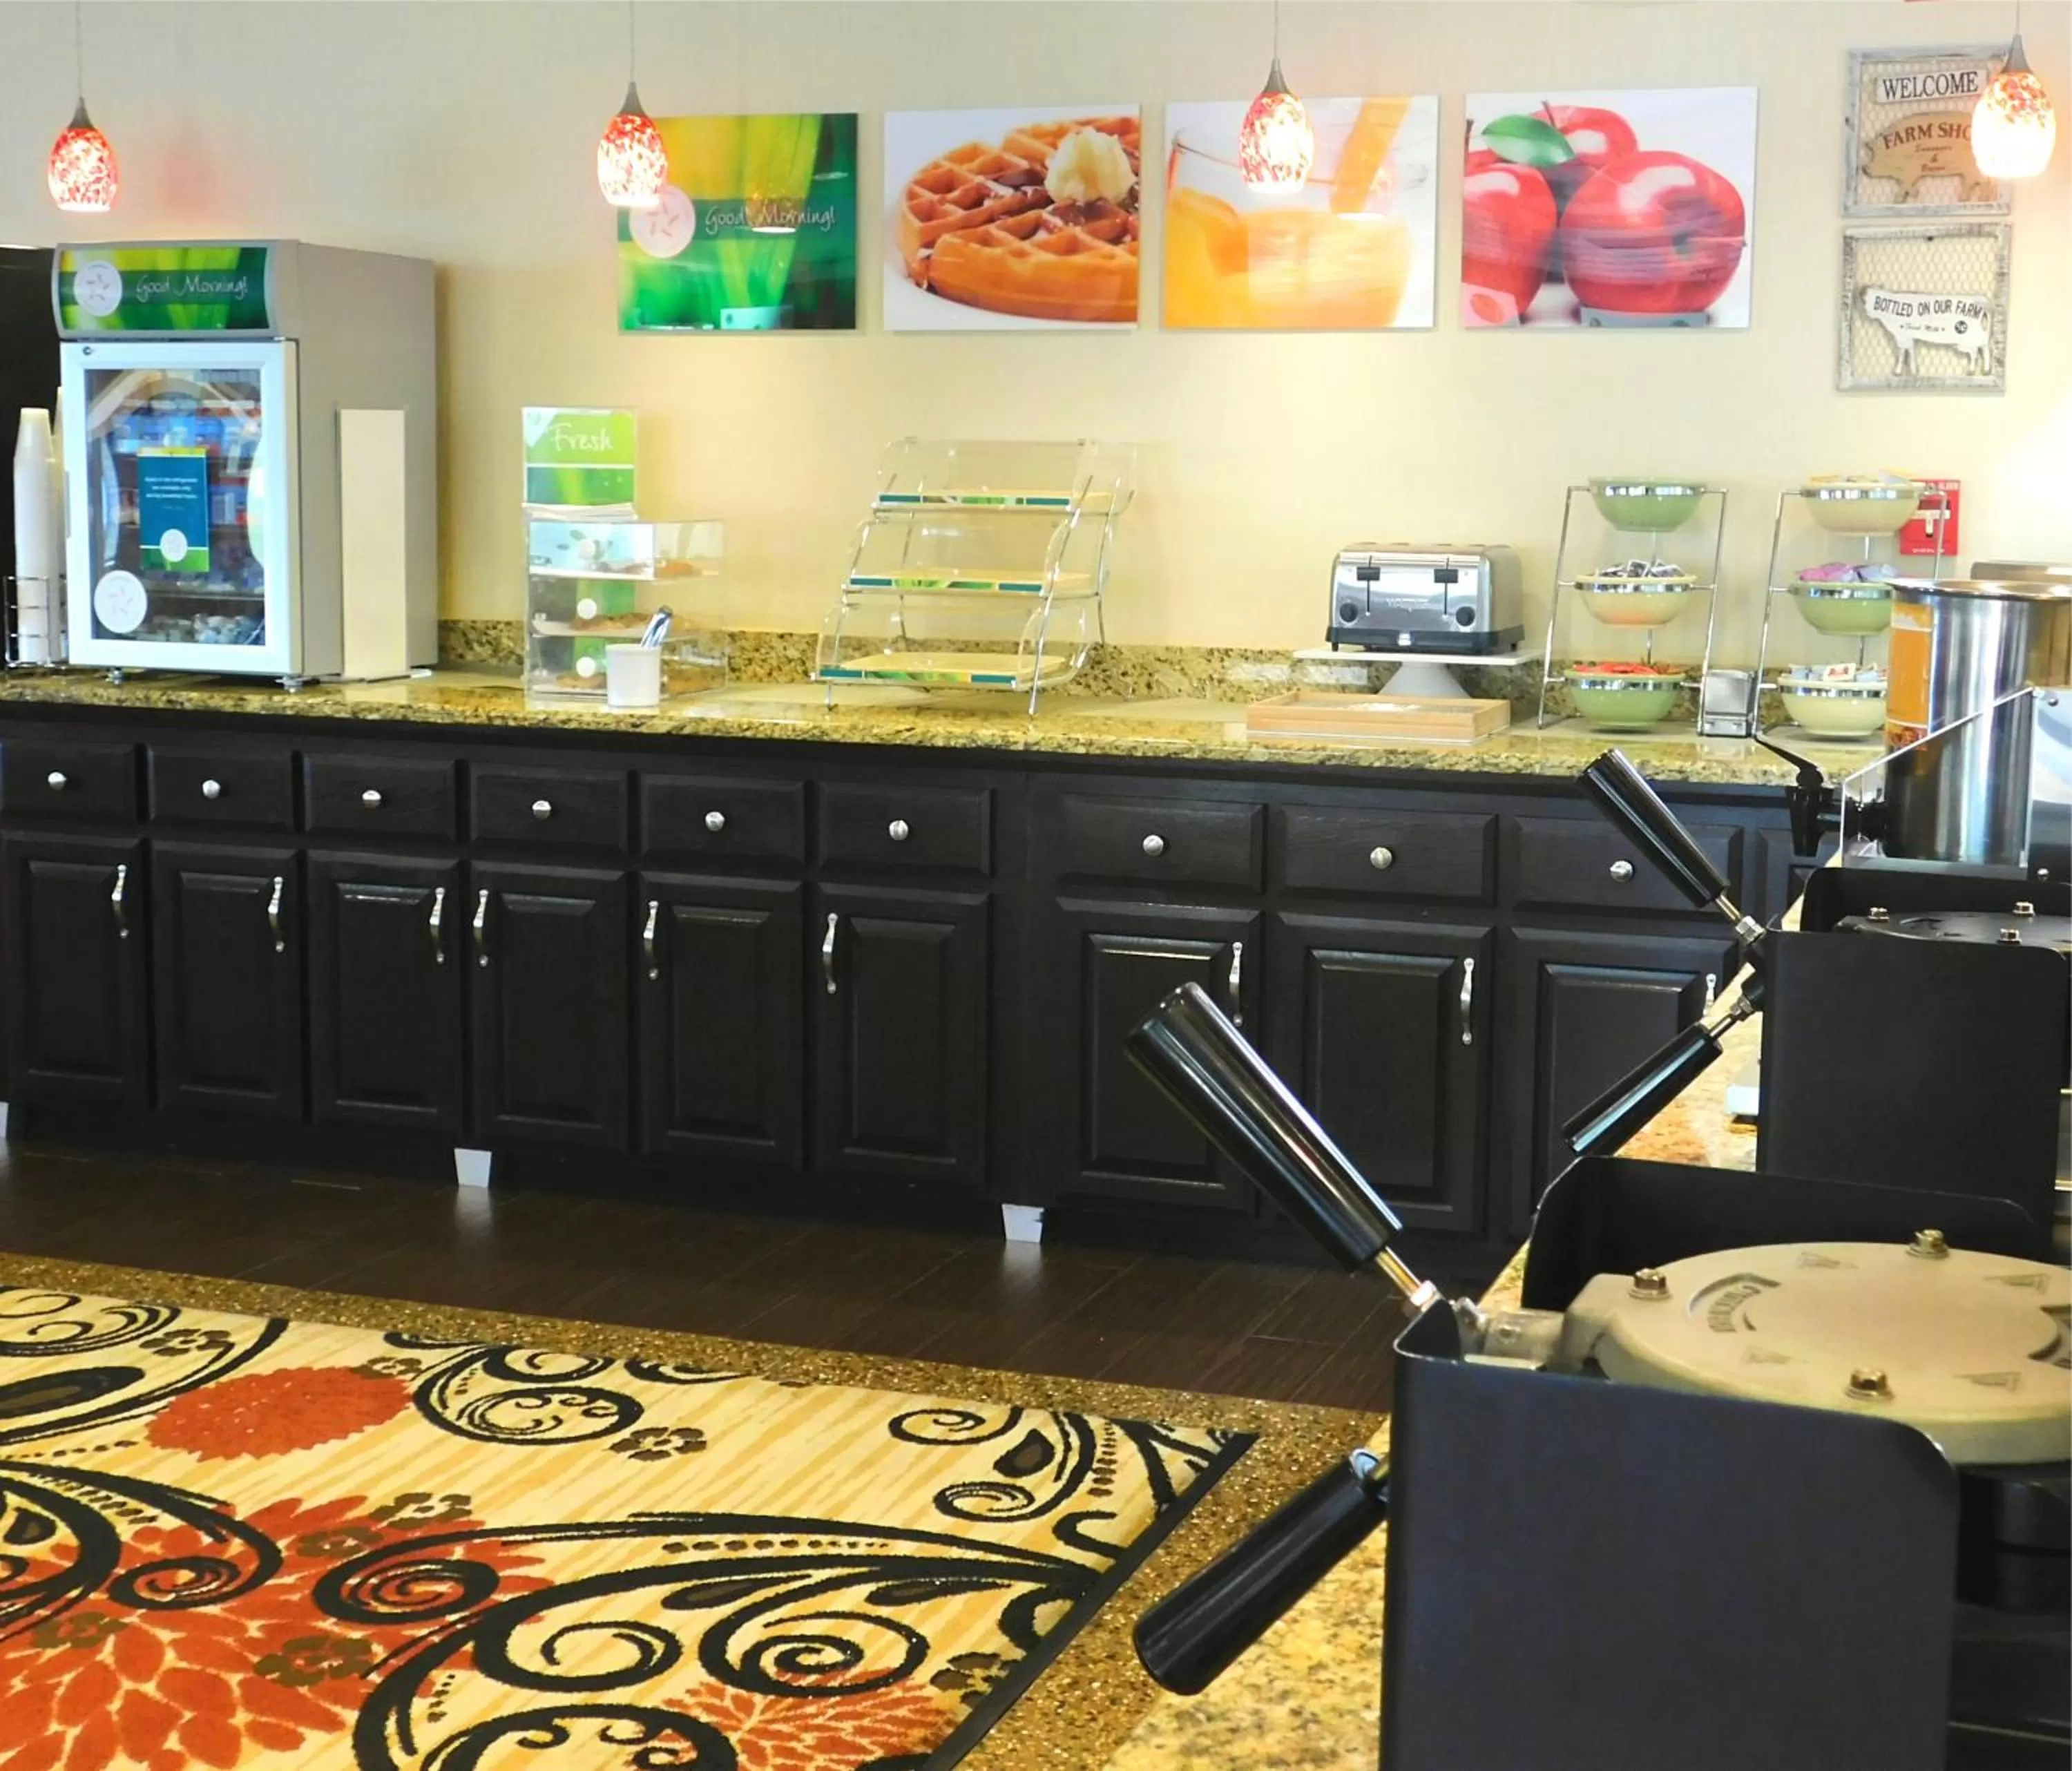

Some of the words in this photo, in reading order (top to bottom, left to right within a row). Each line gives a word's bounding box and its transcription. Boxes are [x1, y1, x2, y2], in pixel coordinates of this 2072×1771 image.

[1883, 71, 1979, 99] WELCOME
[1882, 122, 1933, 150] FARM
[1937, 122, 1970, 141] SHO
[704, 205, 746, 235] Good
[136, 274, 170, 302] Good
[175, 275, 247, 300] Morning!
[1874, 296, 1912, 317] BOTTLED
[1917, 301, 1930, 316] ON
[1934, 299, 1952, 314] OUR
[1955, 300, 1983, 319] FARM
[547, 423, 613, 451] Fresh
